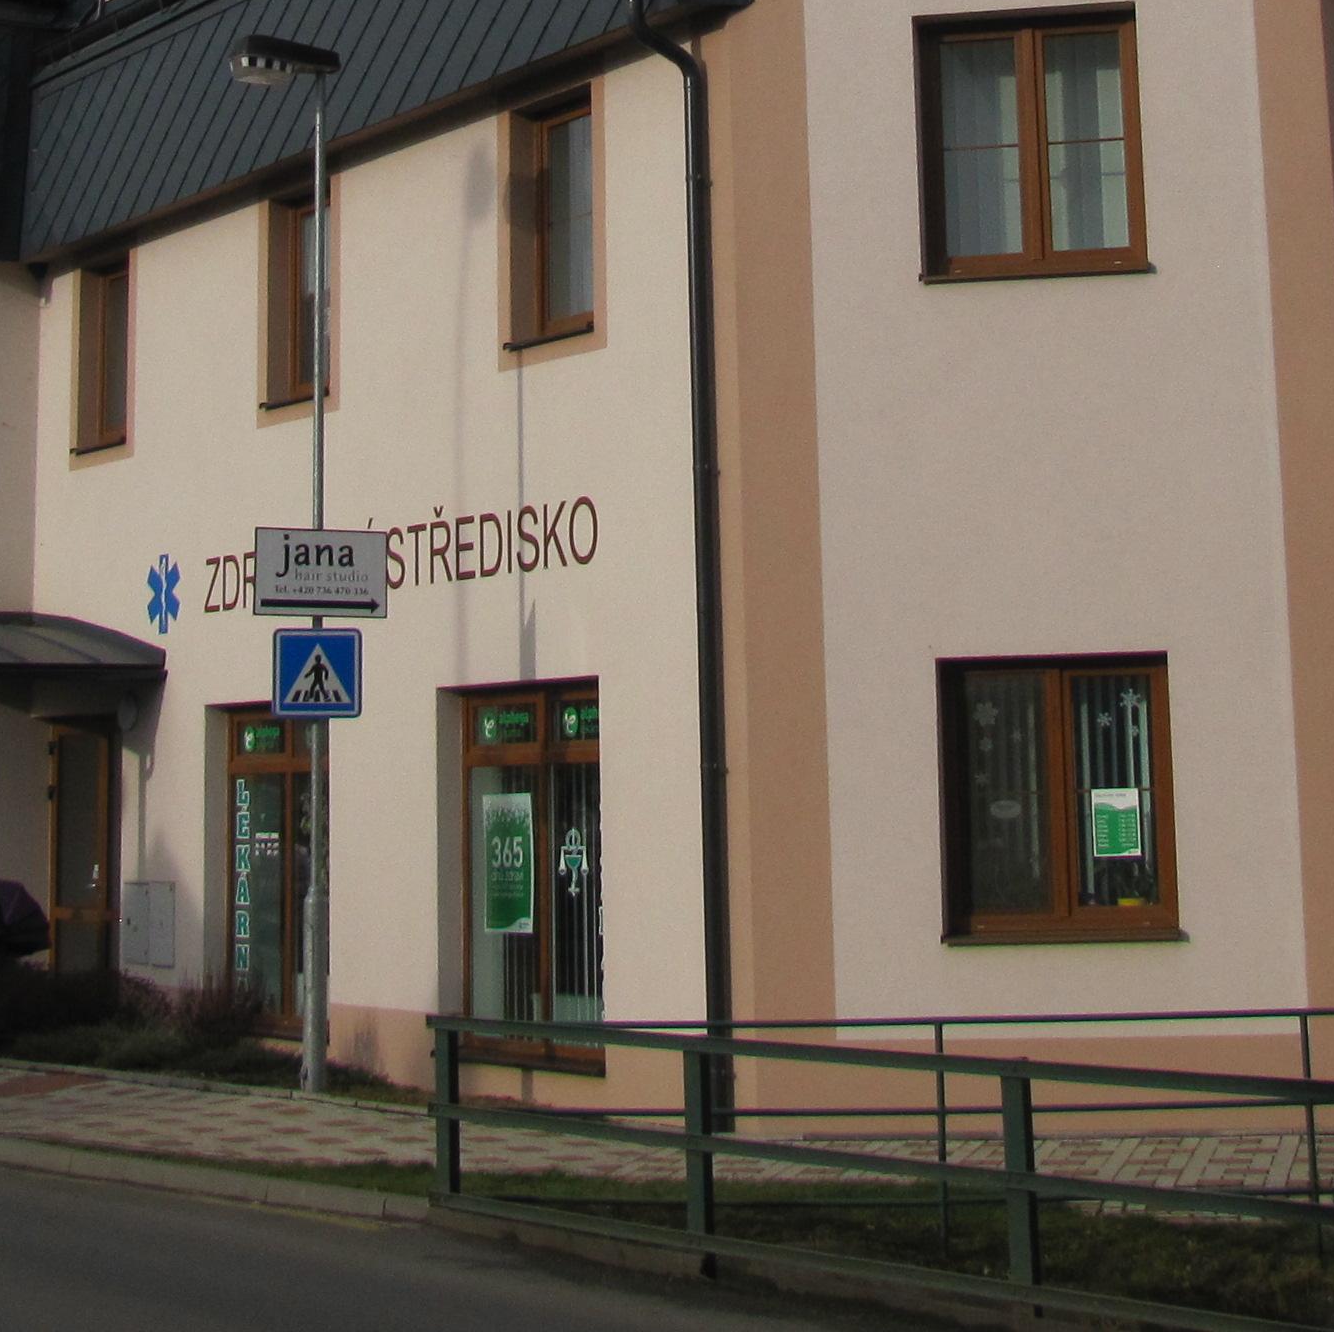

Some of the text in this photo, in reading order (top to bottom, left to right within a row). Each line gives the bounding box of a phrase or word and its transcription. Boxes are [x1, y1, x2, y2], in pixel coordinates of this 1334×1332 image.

[275, 534, 355, 577] jana
[386, 496, 598, 589] STŘEDISKO
[295, 568, 369, 583] hair studio
[491, 835, 524, 868] 365
